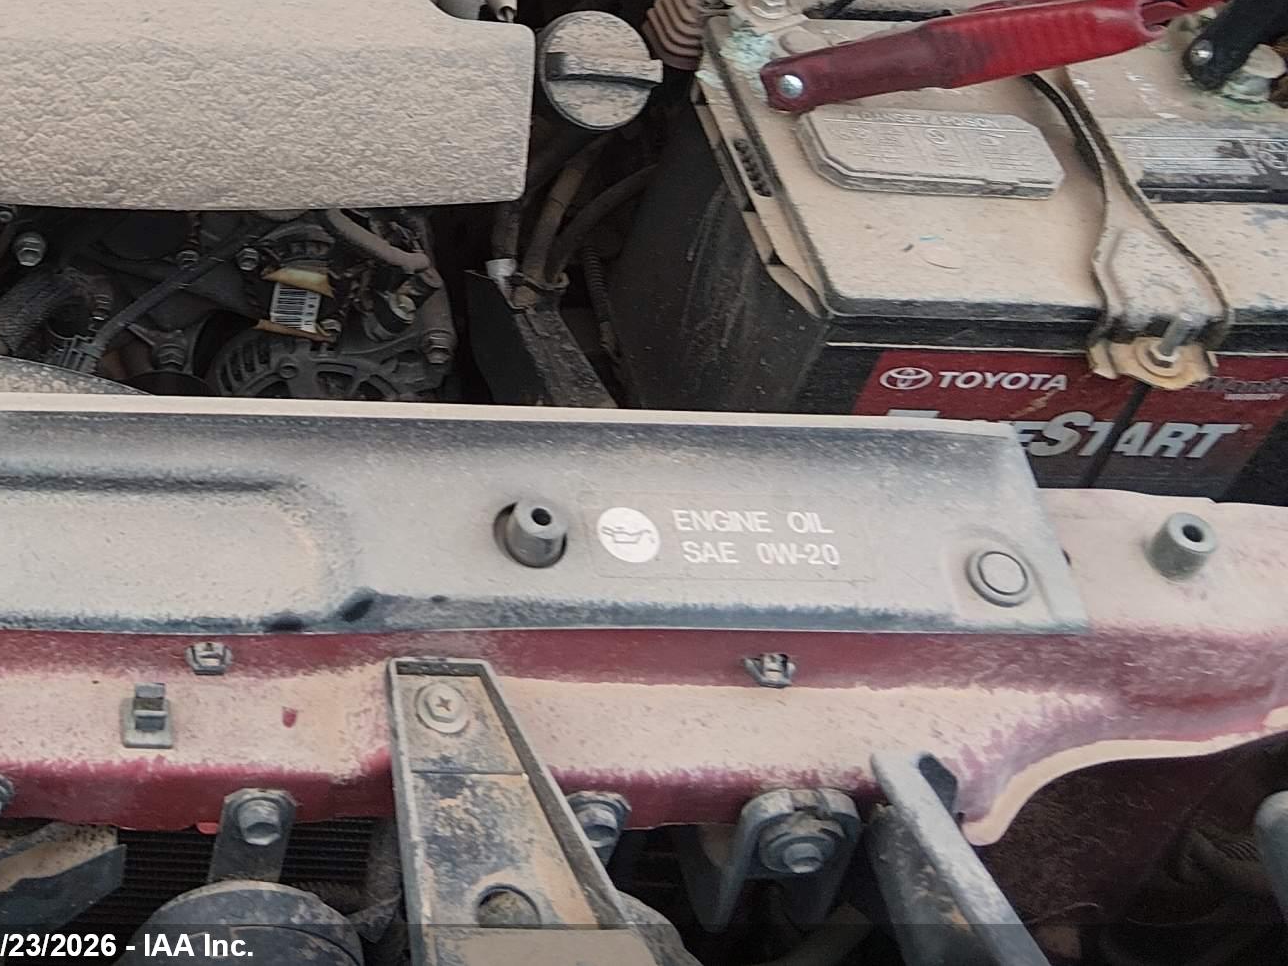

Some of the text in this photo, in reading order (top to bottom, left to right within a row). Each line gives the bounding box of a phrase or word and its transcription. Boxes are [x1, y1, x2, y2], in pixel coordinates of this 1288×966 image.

[938, 371, 1069, 391] TOYOTA
[671, 509, 834, 534] ENGINE OIL
[681, 540, 840, 566] SAE 0W-20
